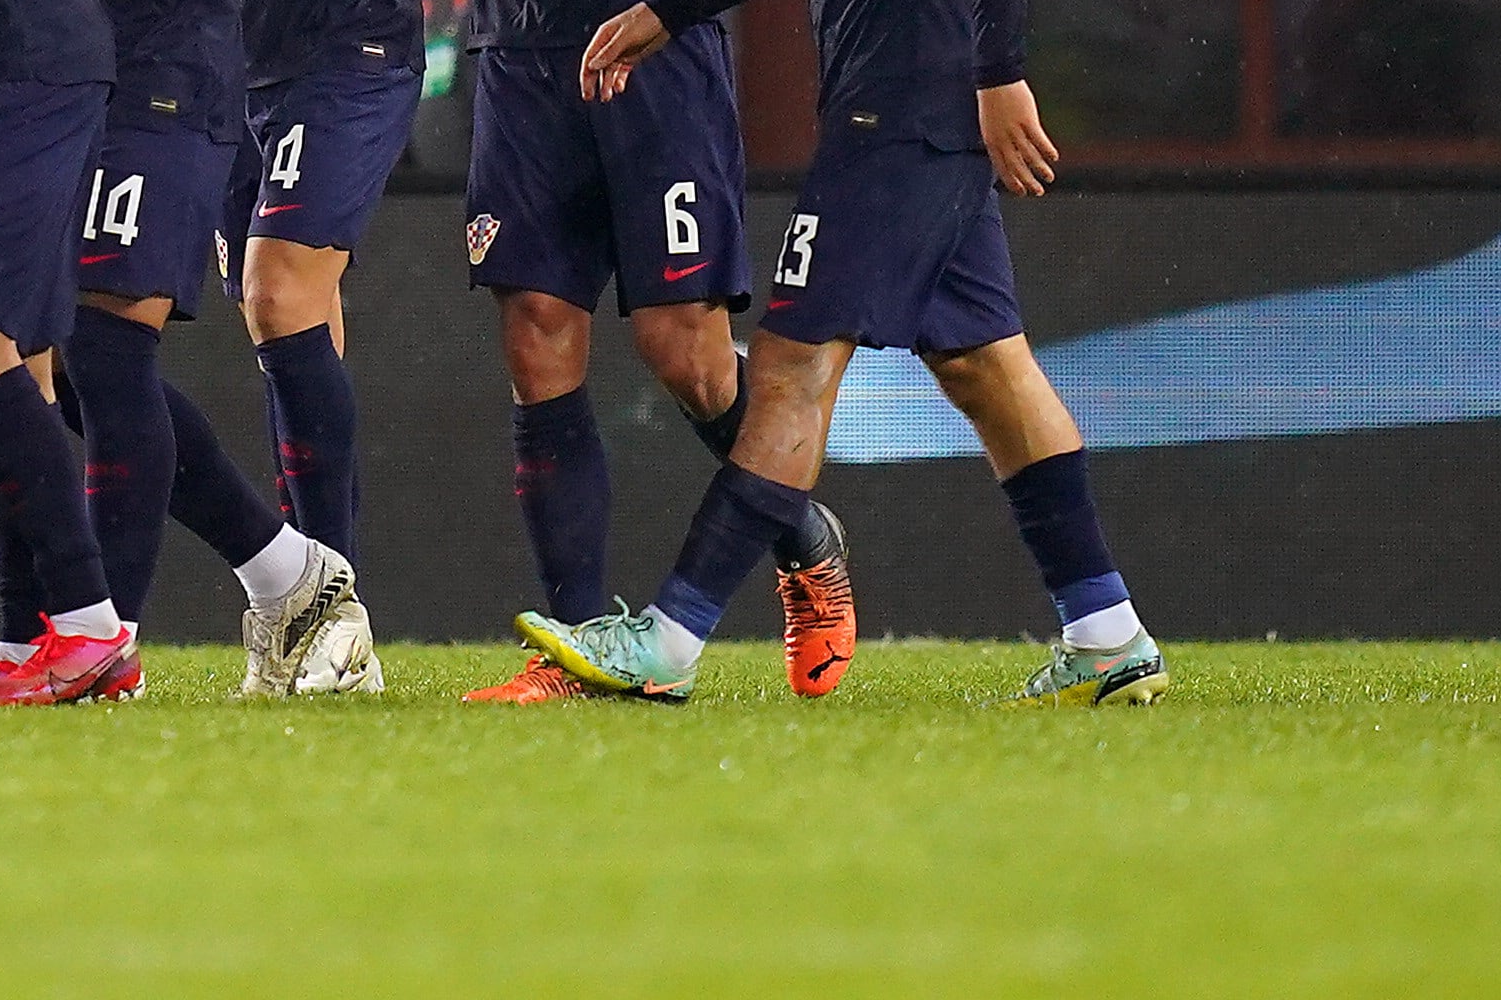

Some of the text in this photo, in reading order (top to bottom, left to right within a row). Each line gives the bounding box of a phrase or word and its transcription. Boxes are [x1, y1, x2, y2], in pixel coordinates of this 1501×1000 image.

[268, 123, 305, 190] 4
[83, 168, 144, 247] 14
[663, 181, 700, 255] 6
